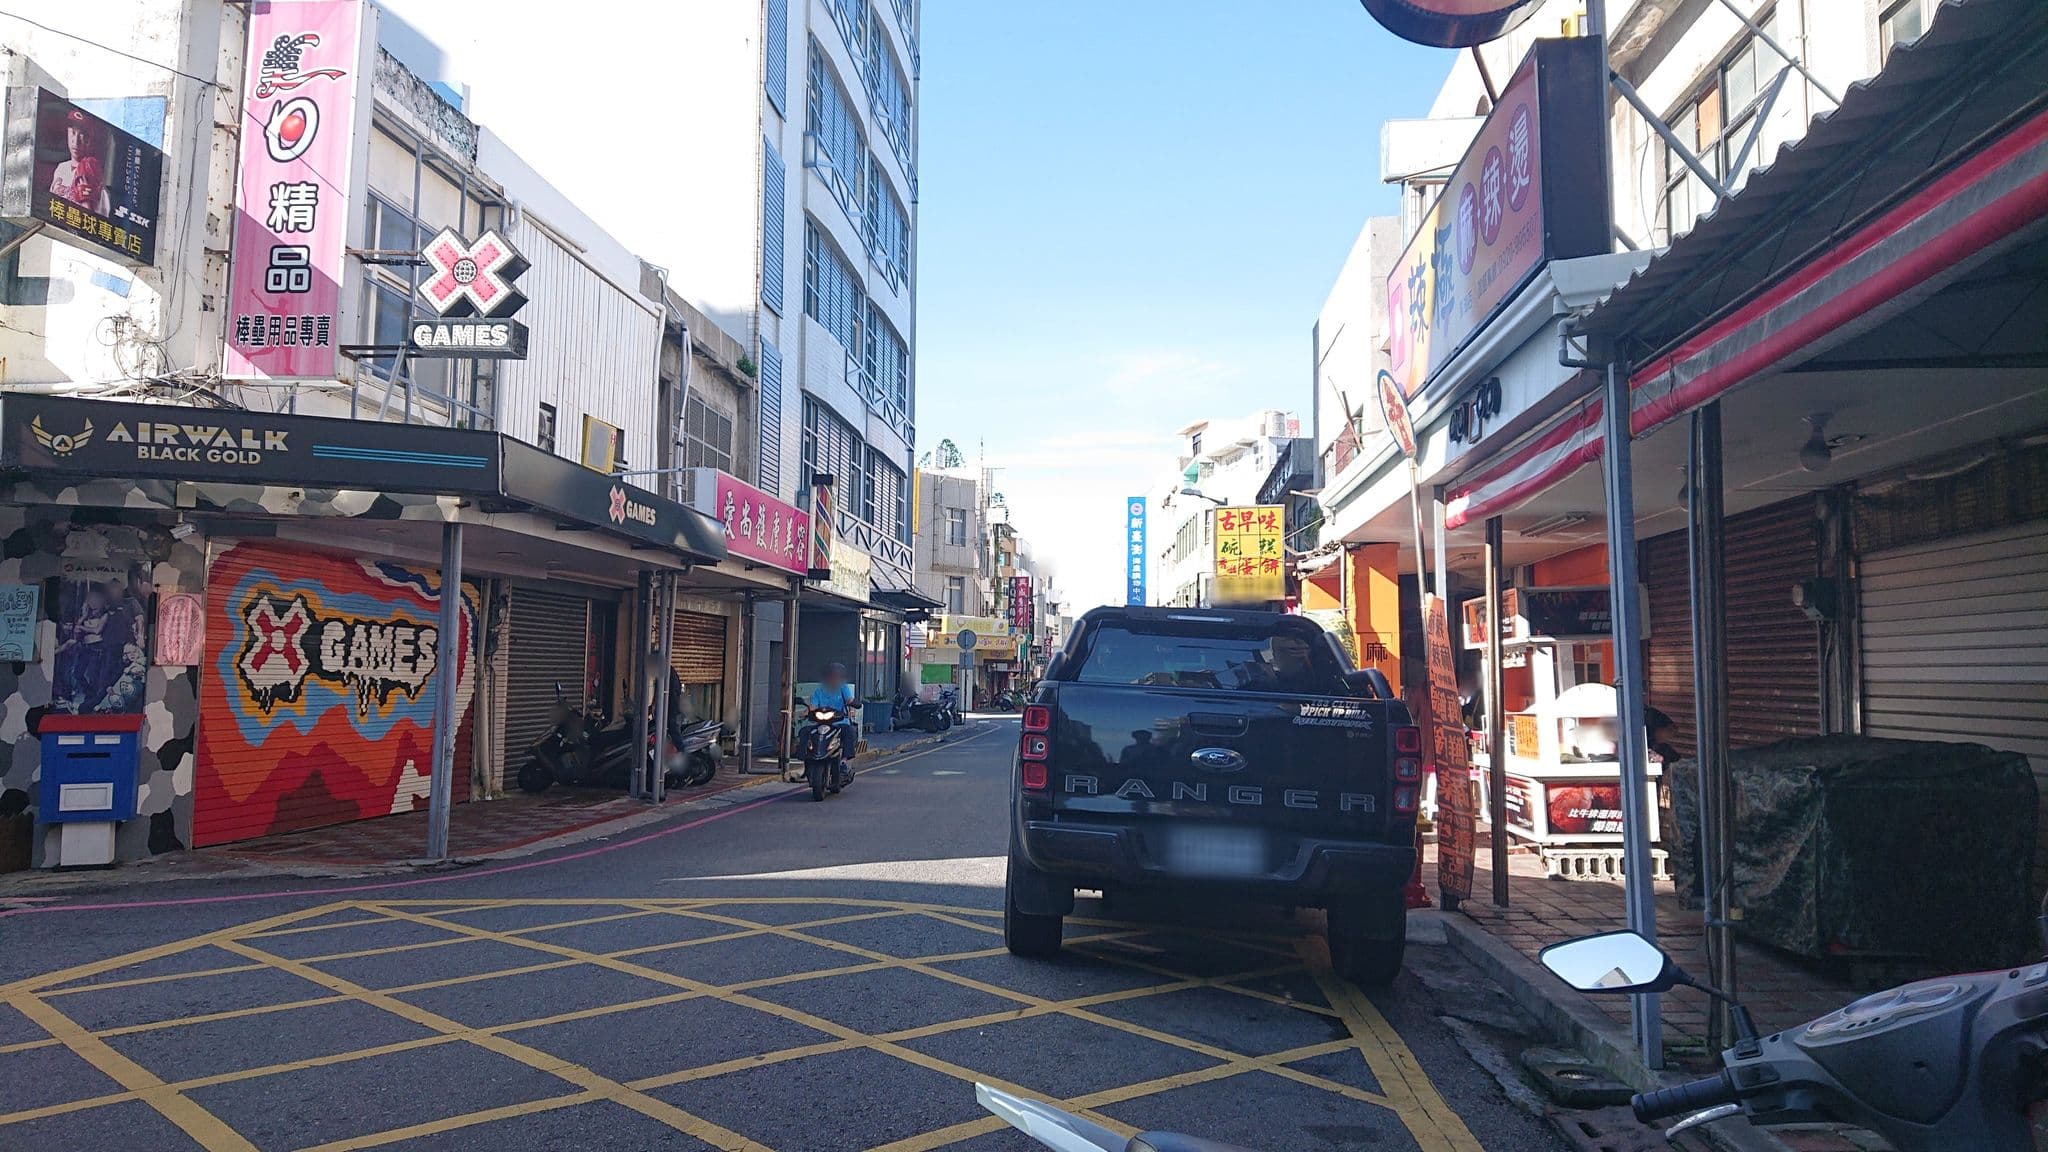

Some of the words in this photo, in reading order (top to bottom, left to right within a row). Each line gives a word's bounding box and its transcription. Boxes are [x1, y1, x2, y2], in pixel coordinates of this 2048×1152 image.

[234, 314, 331, 348] 棒壘用品專賣
[413, 324, 508, 347] GAMES
[105, 421, 289, 452] AIRWALK
[137, 445, 200, 462] BLACK
[206, 449, 261, 465] GOLD
[626, 500, 656, 526] GAMES
[1218, 510, 1280, 533] 古早味
[320, 620, 438, 686] GAMES
[1307, 706, 1331, 717] PICK
[1344, 709, 1367, 720] BULL
[1064, 774, 1376, 814] RANGER
